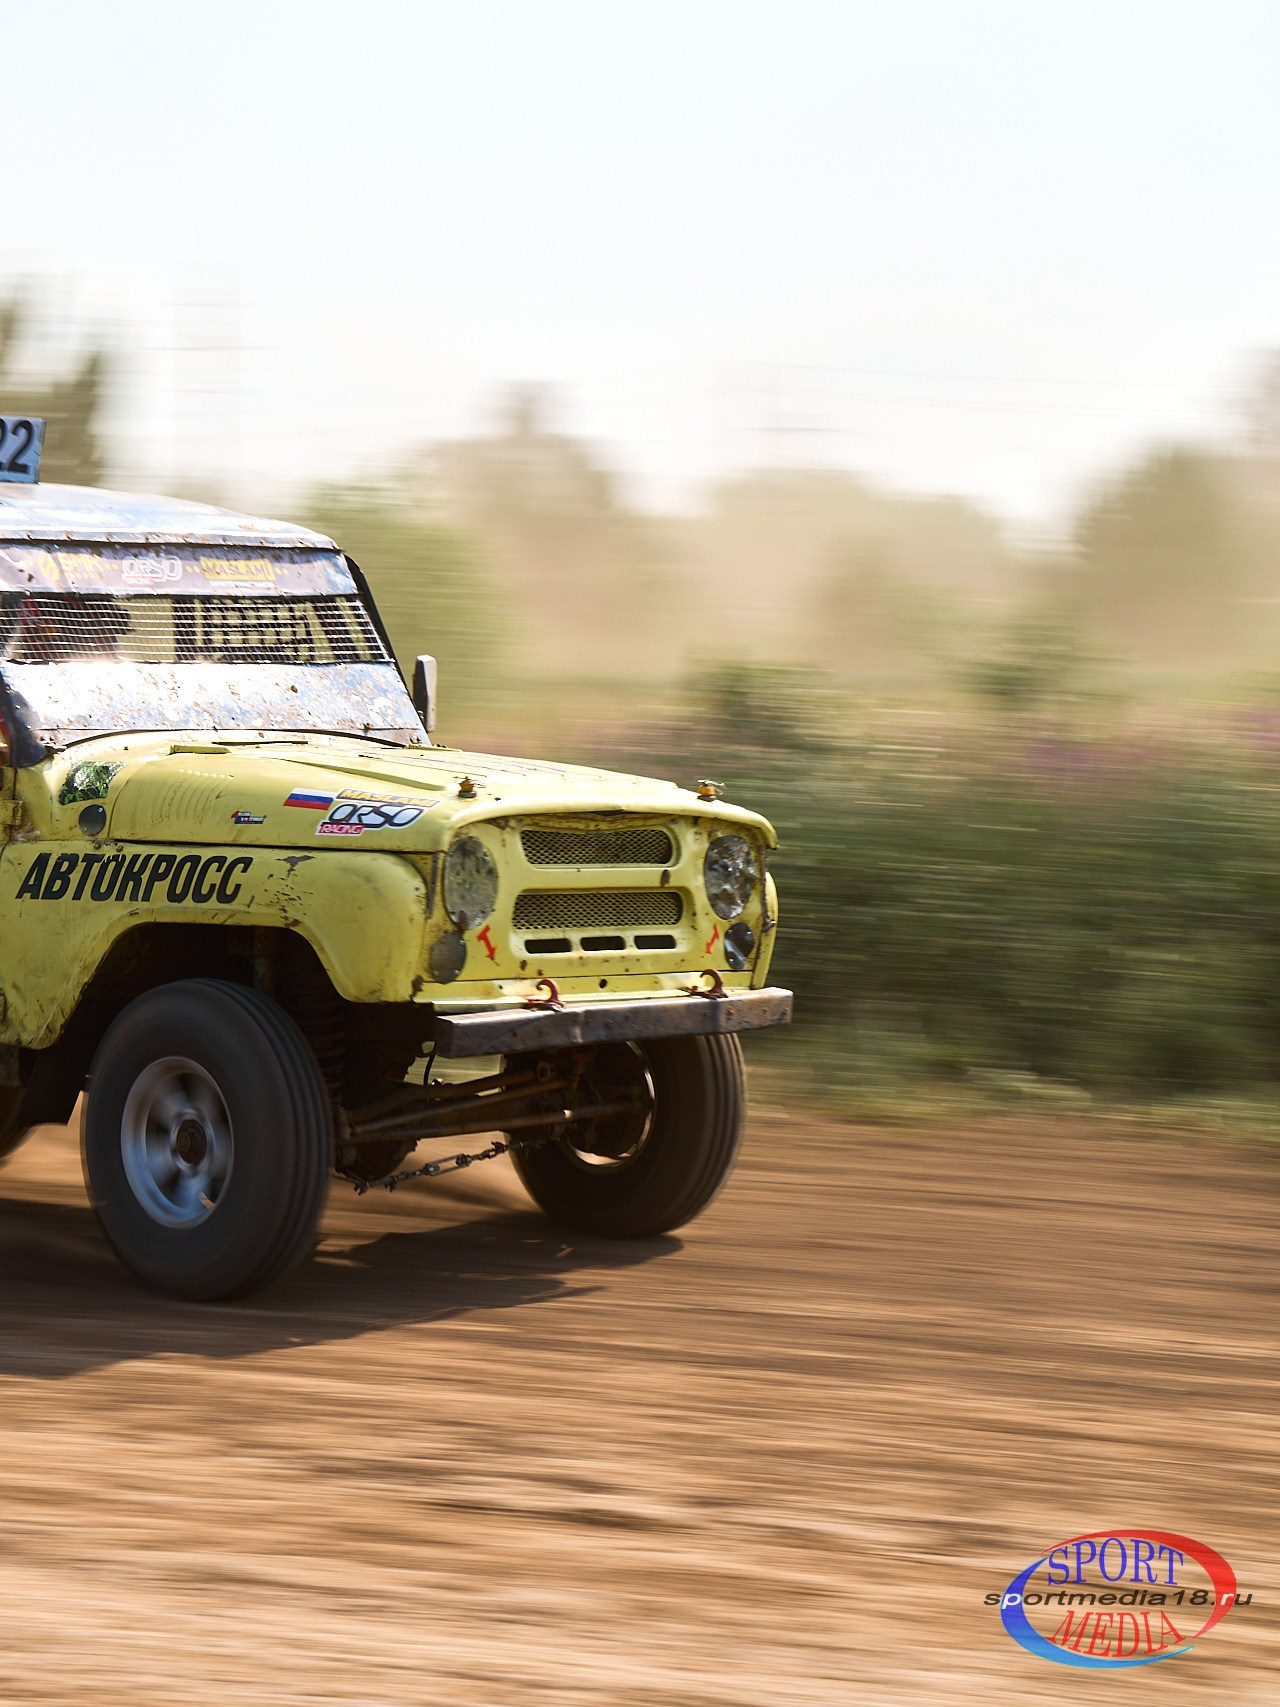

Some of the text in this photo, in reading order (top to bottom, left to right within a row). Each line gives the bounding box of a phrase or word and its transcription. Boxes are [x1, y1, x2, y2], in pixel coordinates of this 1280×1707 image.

[329, 803, 424, 828] ORSO
[320, 824, 362, 834] RACING
[15, 852, 254, 904] АВТОКРОСС
